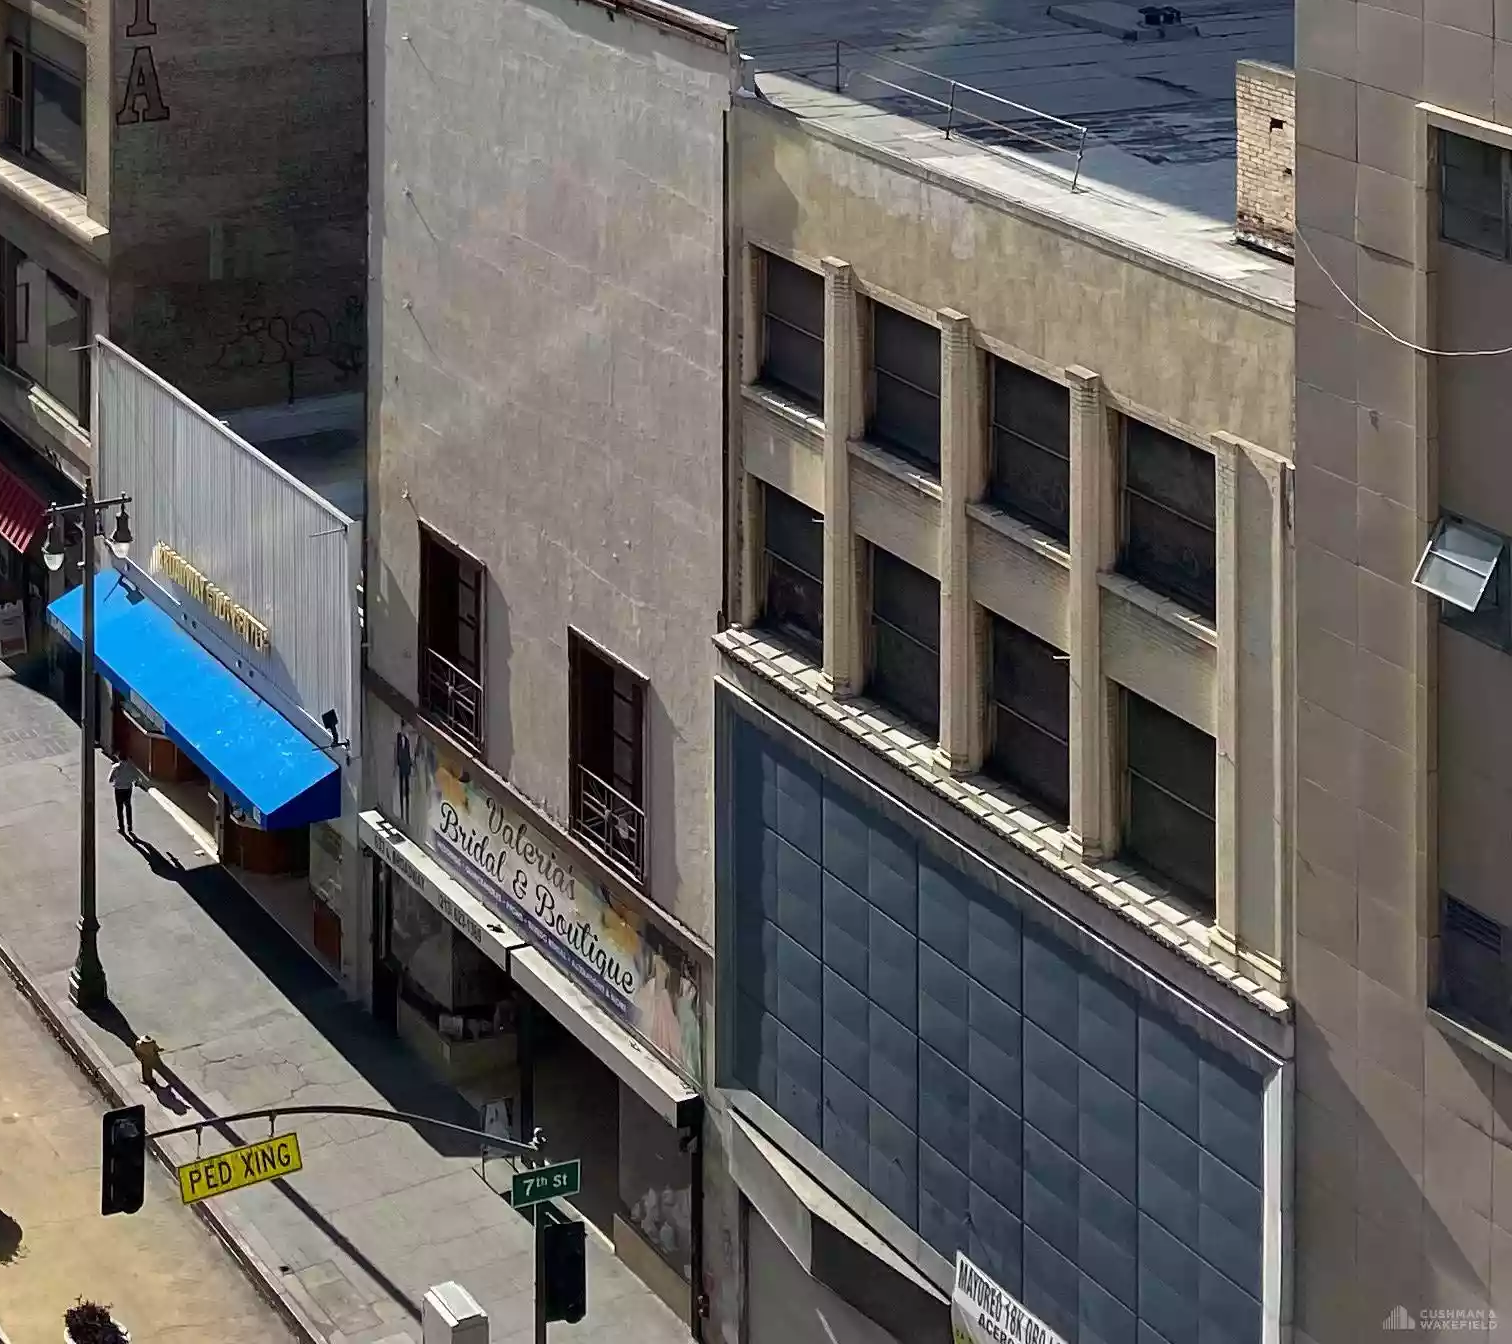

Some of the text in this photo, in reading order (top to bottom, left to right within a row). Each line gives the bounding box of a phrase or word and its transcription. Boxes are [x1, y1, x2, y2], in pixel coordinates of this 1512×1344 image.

[486, 797, 576, 900] Valeria's
[440, 801, 508, 883] Bridal
[513, 869, 529, 900] &
[534, 884, 636, 995] Boutique
[189, 1143, 290, 1194] PED XING
[523, 1173, 568, 1196] 7th St
[1005, 1300, 1024, 1342] 18K
